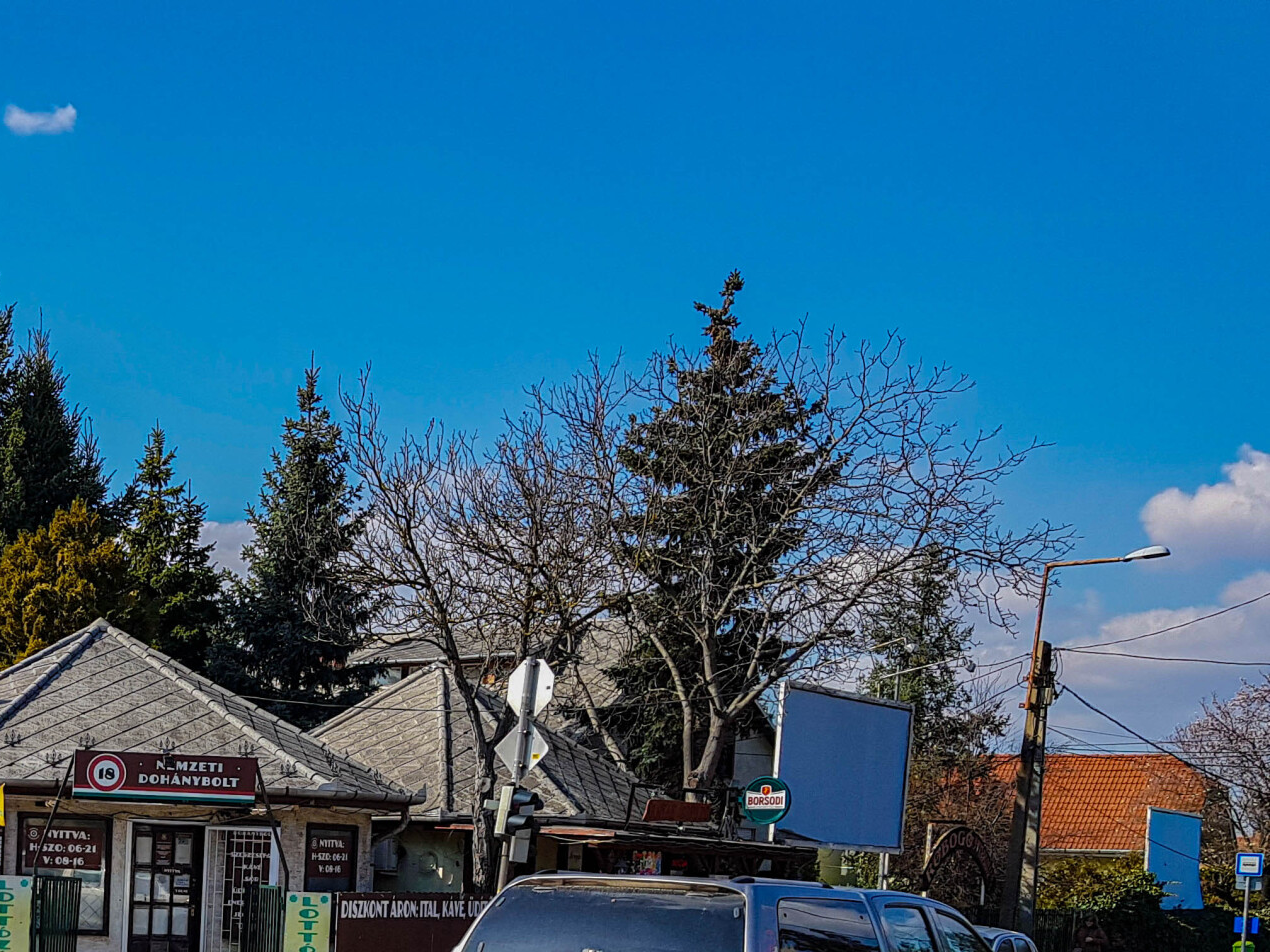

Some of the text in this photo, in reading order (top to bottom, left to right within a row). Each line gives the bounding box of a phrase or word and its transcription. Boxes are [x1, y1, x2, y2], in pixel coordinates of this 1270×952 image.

[98, 767, 116, 780] 18
[138, 773, 240, 788] DOHÁNYBOLT
[747, 796, 783, 805] BORSODI
[68, 844, 96, 853] 06-21
[319, 839, 345, 848] NYITVA:
[43, 856, 84, 866] V: 08-16
[341, 895, 493, 919] DISZKONT ÁRON: ITAL, KÁVÉ, ÜDÍ
